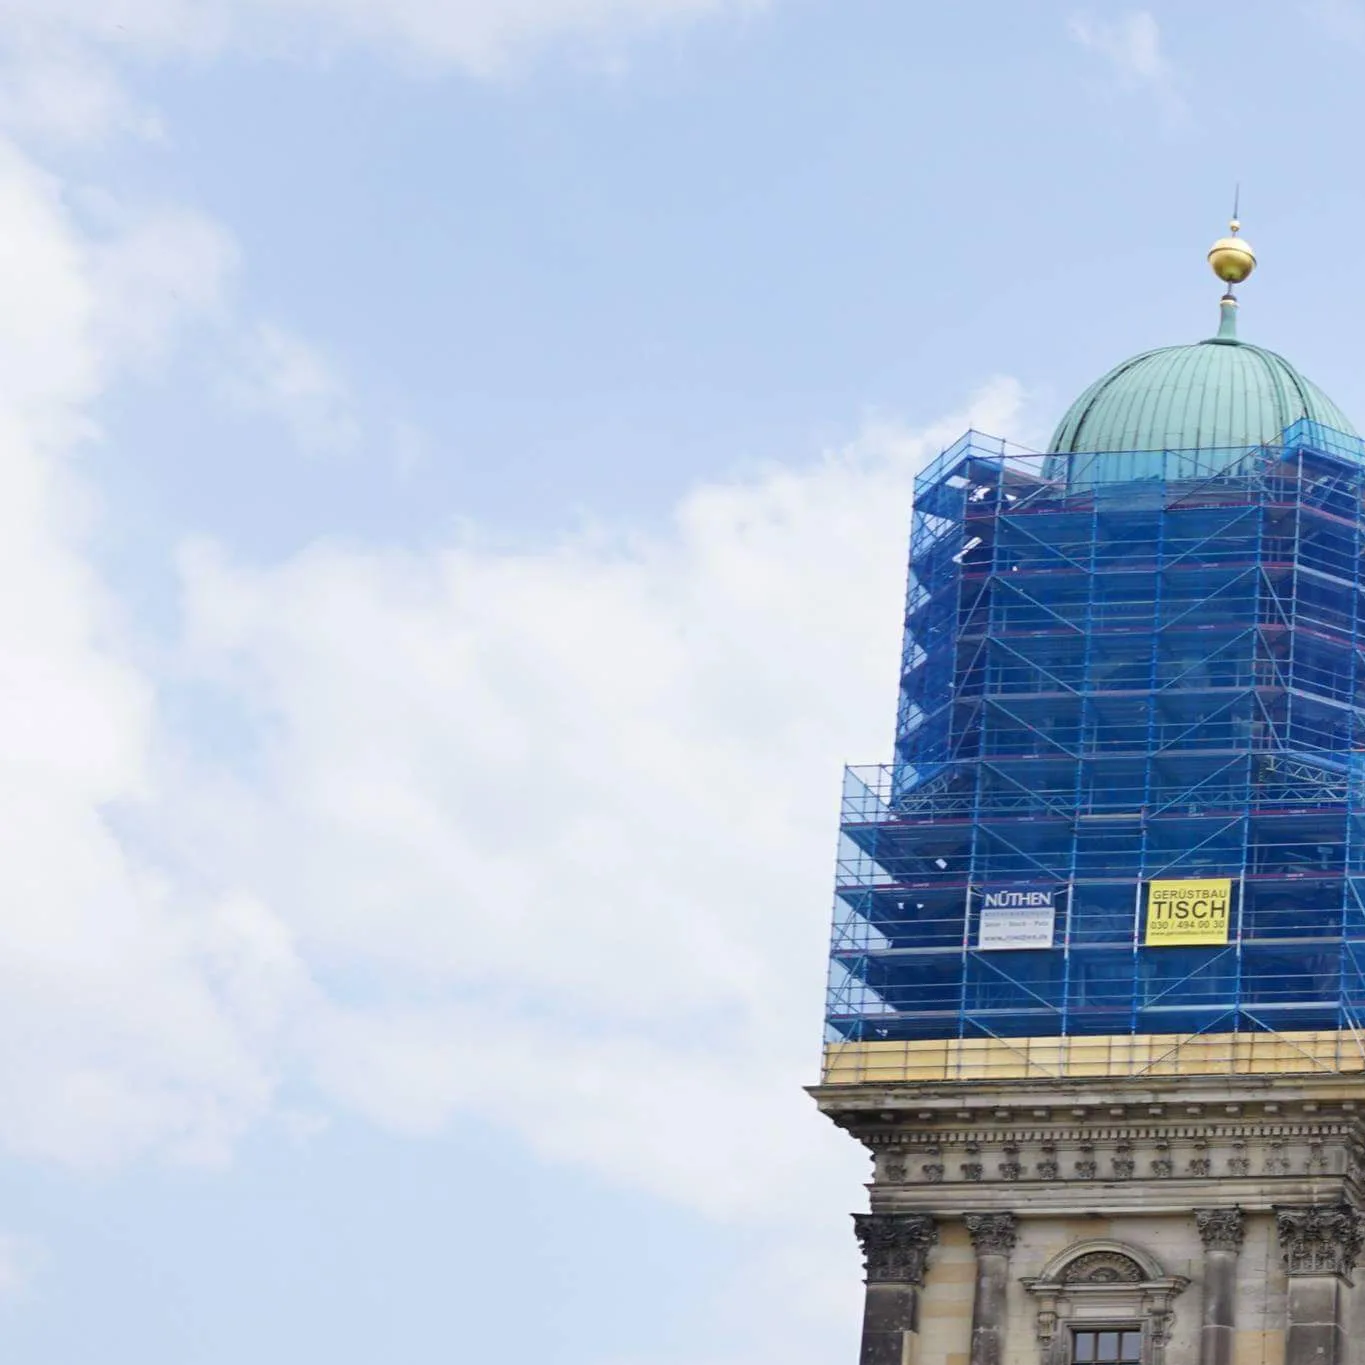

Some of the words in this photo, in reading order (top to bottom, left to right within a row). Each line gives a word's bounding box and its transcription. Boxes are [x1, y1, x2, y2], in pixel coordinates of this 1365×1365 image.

[985, 890, 1051, 907] NÜTHEN
[1152, 889, 1227, 900] GERÜSTBAU
[1152, 900, 1226, 919] TISCH
[1151, 921, 1169, 929] 030
[1177, 921, 1195, 929] 494
[1198, 920, 1210, 928] 00
[1213, 920, 1225, 928] 30
